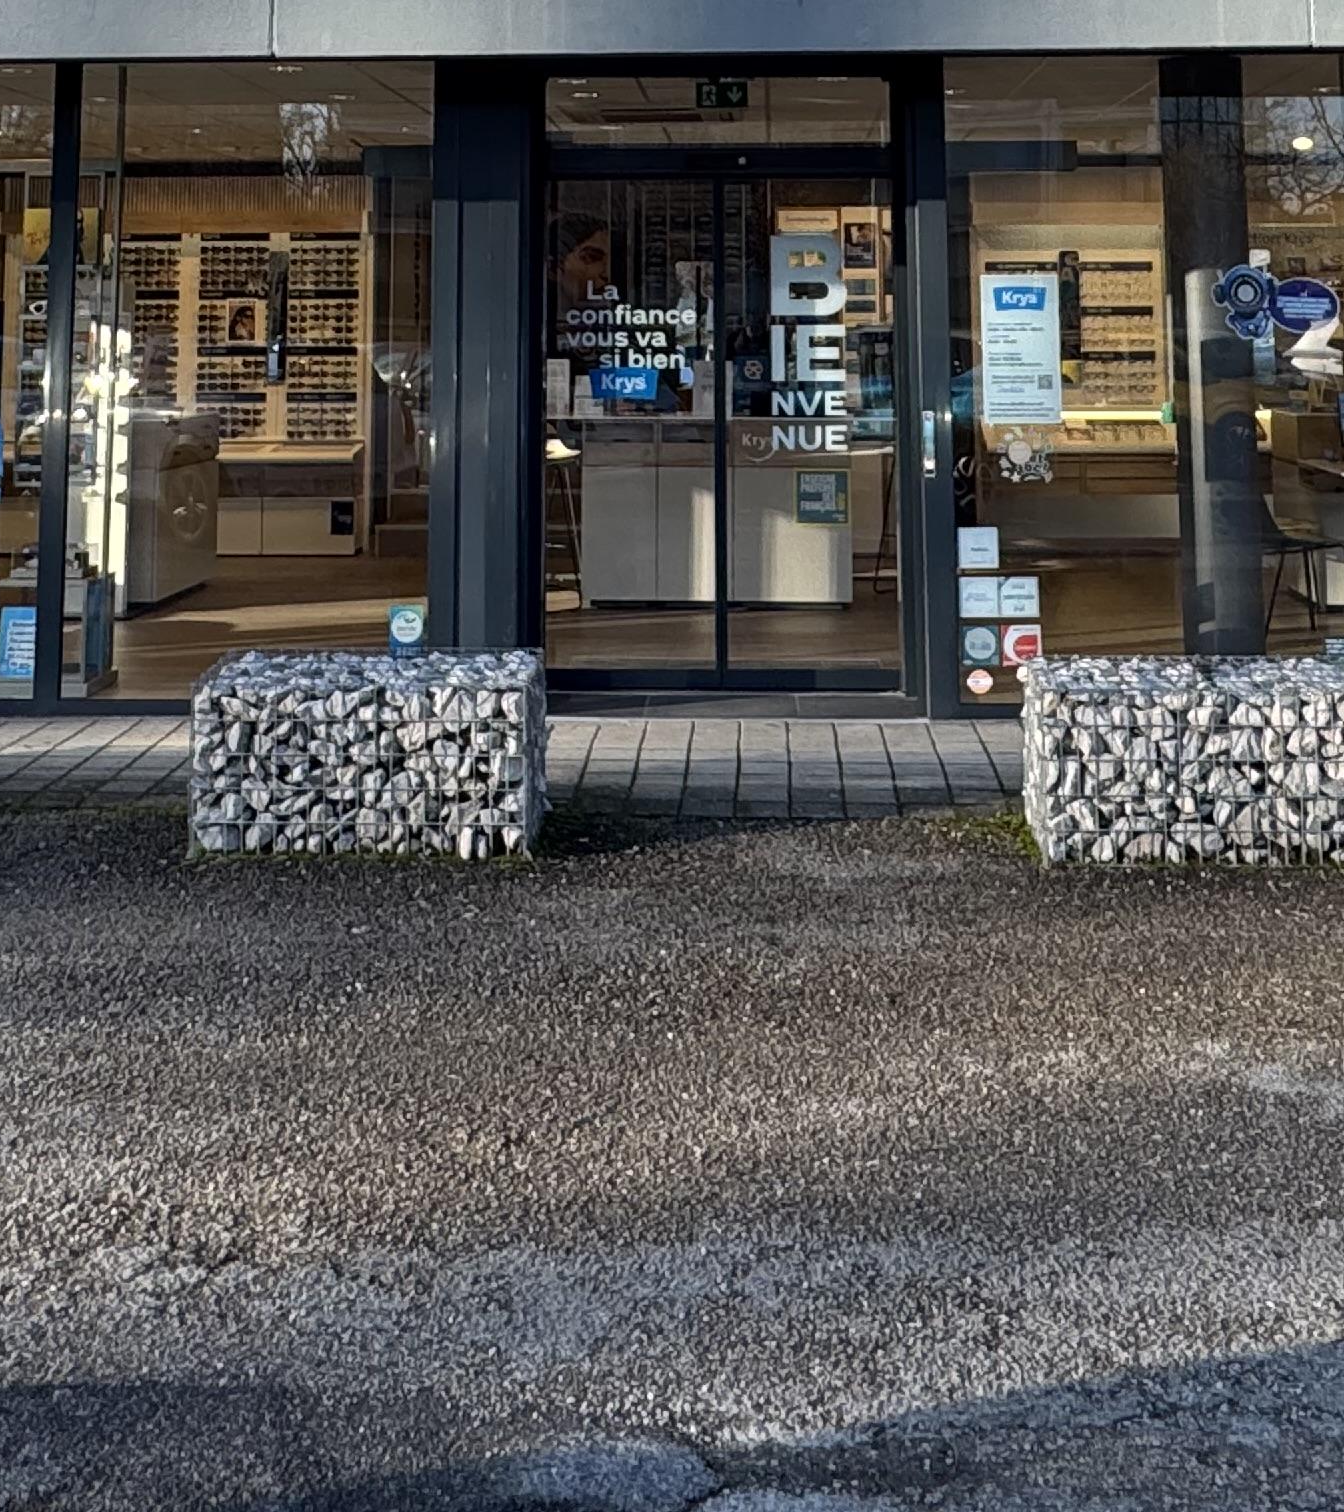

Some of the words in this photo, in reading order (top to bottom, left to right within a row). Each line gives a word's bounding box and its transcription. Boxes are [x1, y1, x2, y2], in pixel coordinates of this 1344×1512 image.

[770, 235, 847, 316] B
[586, 280, 619, 300] La
[1002, 290, 1038, 306] Krys
[566, 304, 697, 325] confiance
[567, 331, 629, 348] vous
[635, 331, 668, 348] va
[599, 348, 621, 370] si
[628, 348, 686, 370] bien
[770, 324, 846, 382] IE
[601, 372, 647, 394] Krys
[771, 390, 848, 416] NVE
[771, 424, 848, 452] NUE
